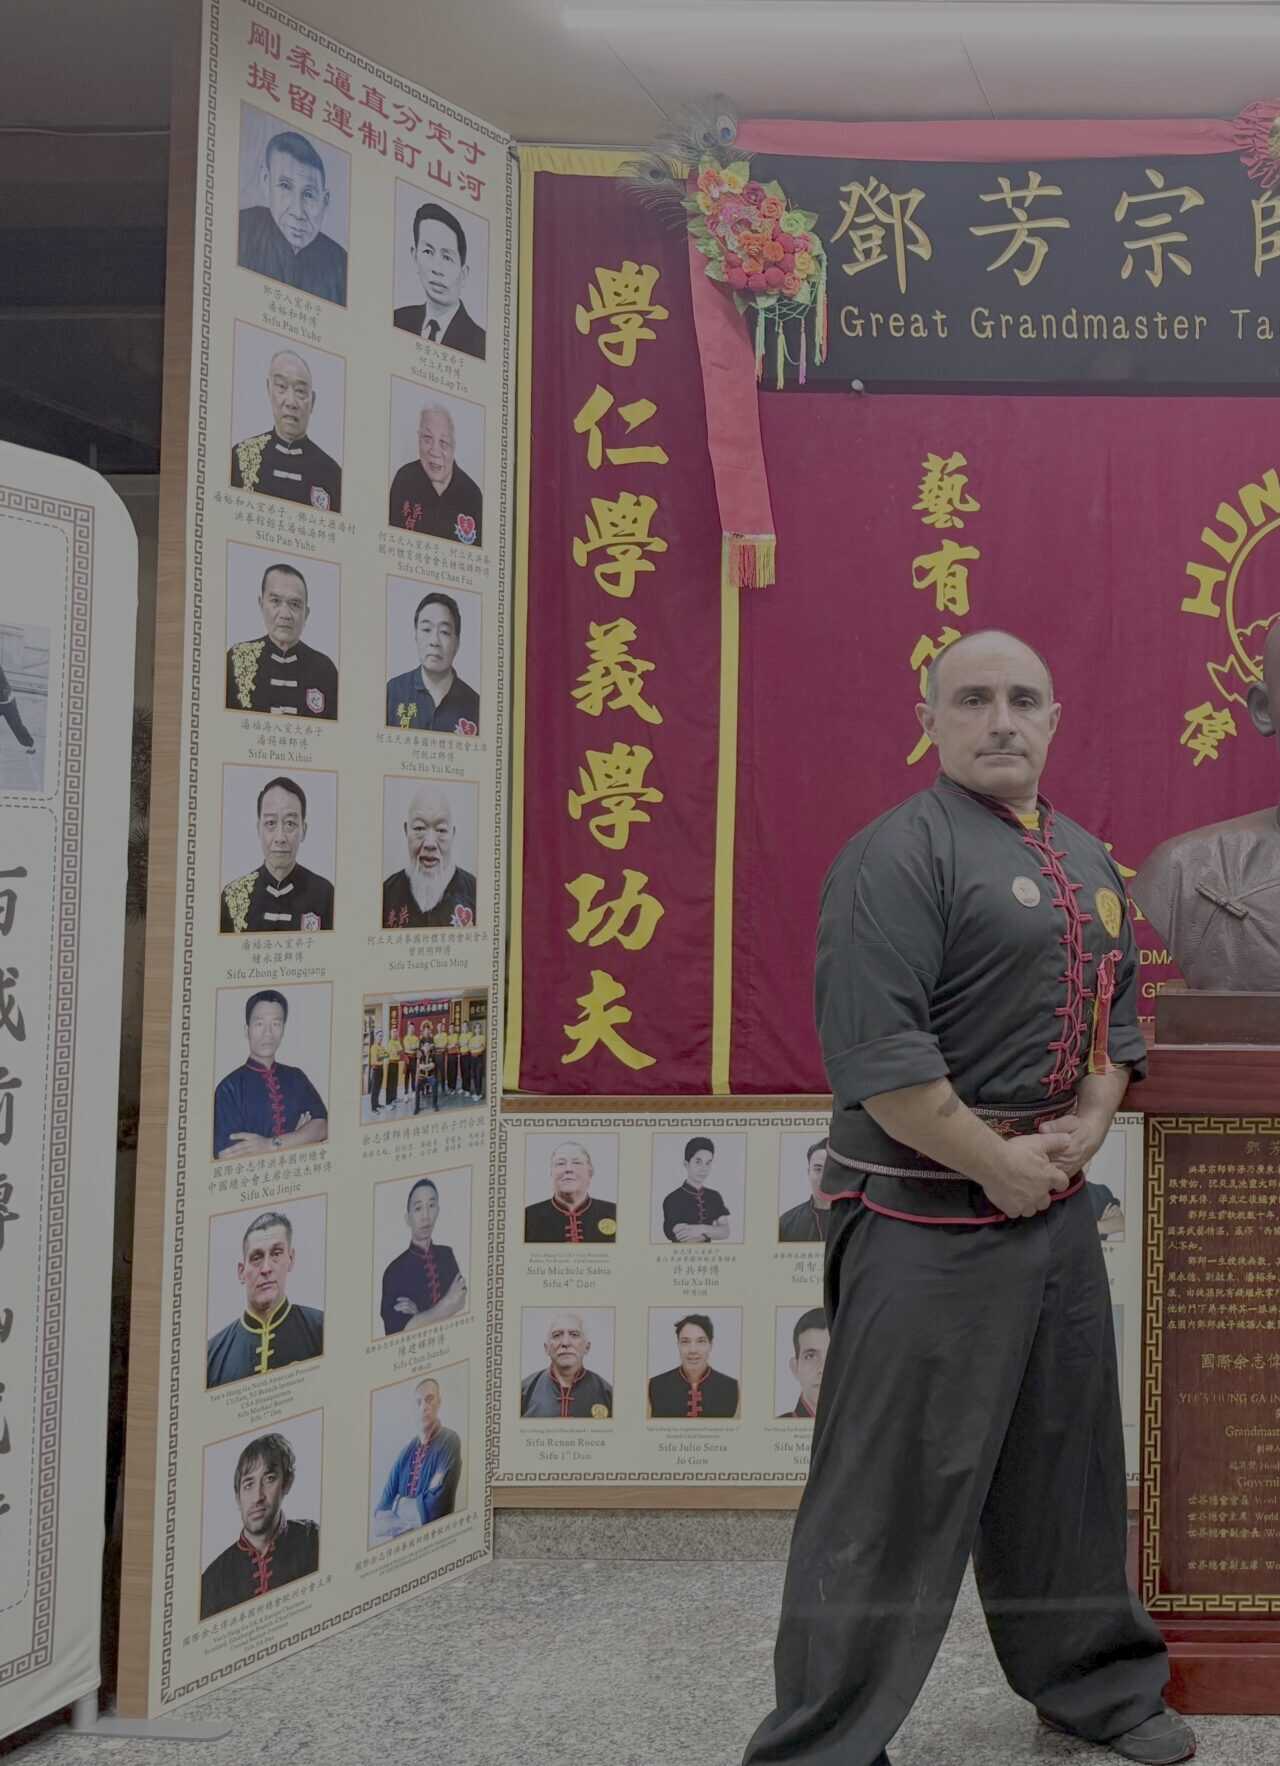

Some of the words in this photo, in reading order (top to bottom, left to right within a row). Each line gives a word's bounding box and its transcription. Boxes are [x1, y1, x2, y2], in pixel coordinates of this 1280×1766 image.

[840, 306, 949, 339] Great
[971, 306, 1207, 341] Grandmaster
[561, 260, 669, 1070] 學仁學義學功夫
[226, 967, 247, 980] Sifu
[248, 966, 278, 981] Zhong
[240, 1188, 260, 1203] Sifu
[543, 1279, 561, 1289] Sifu
[526, 1438, 545, 1448] Sifu
[657, 1443, 679, 1453] Sifu
[774, 1441, 794, 1452] Sifu
[538, 1451, 559, 1461] Sifu
[1255, 1512, 1279, 1521] World
